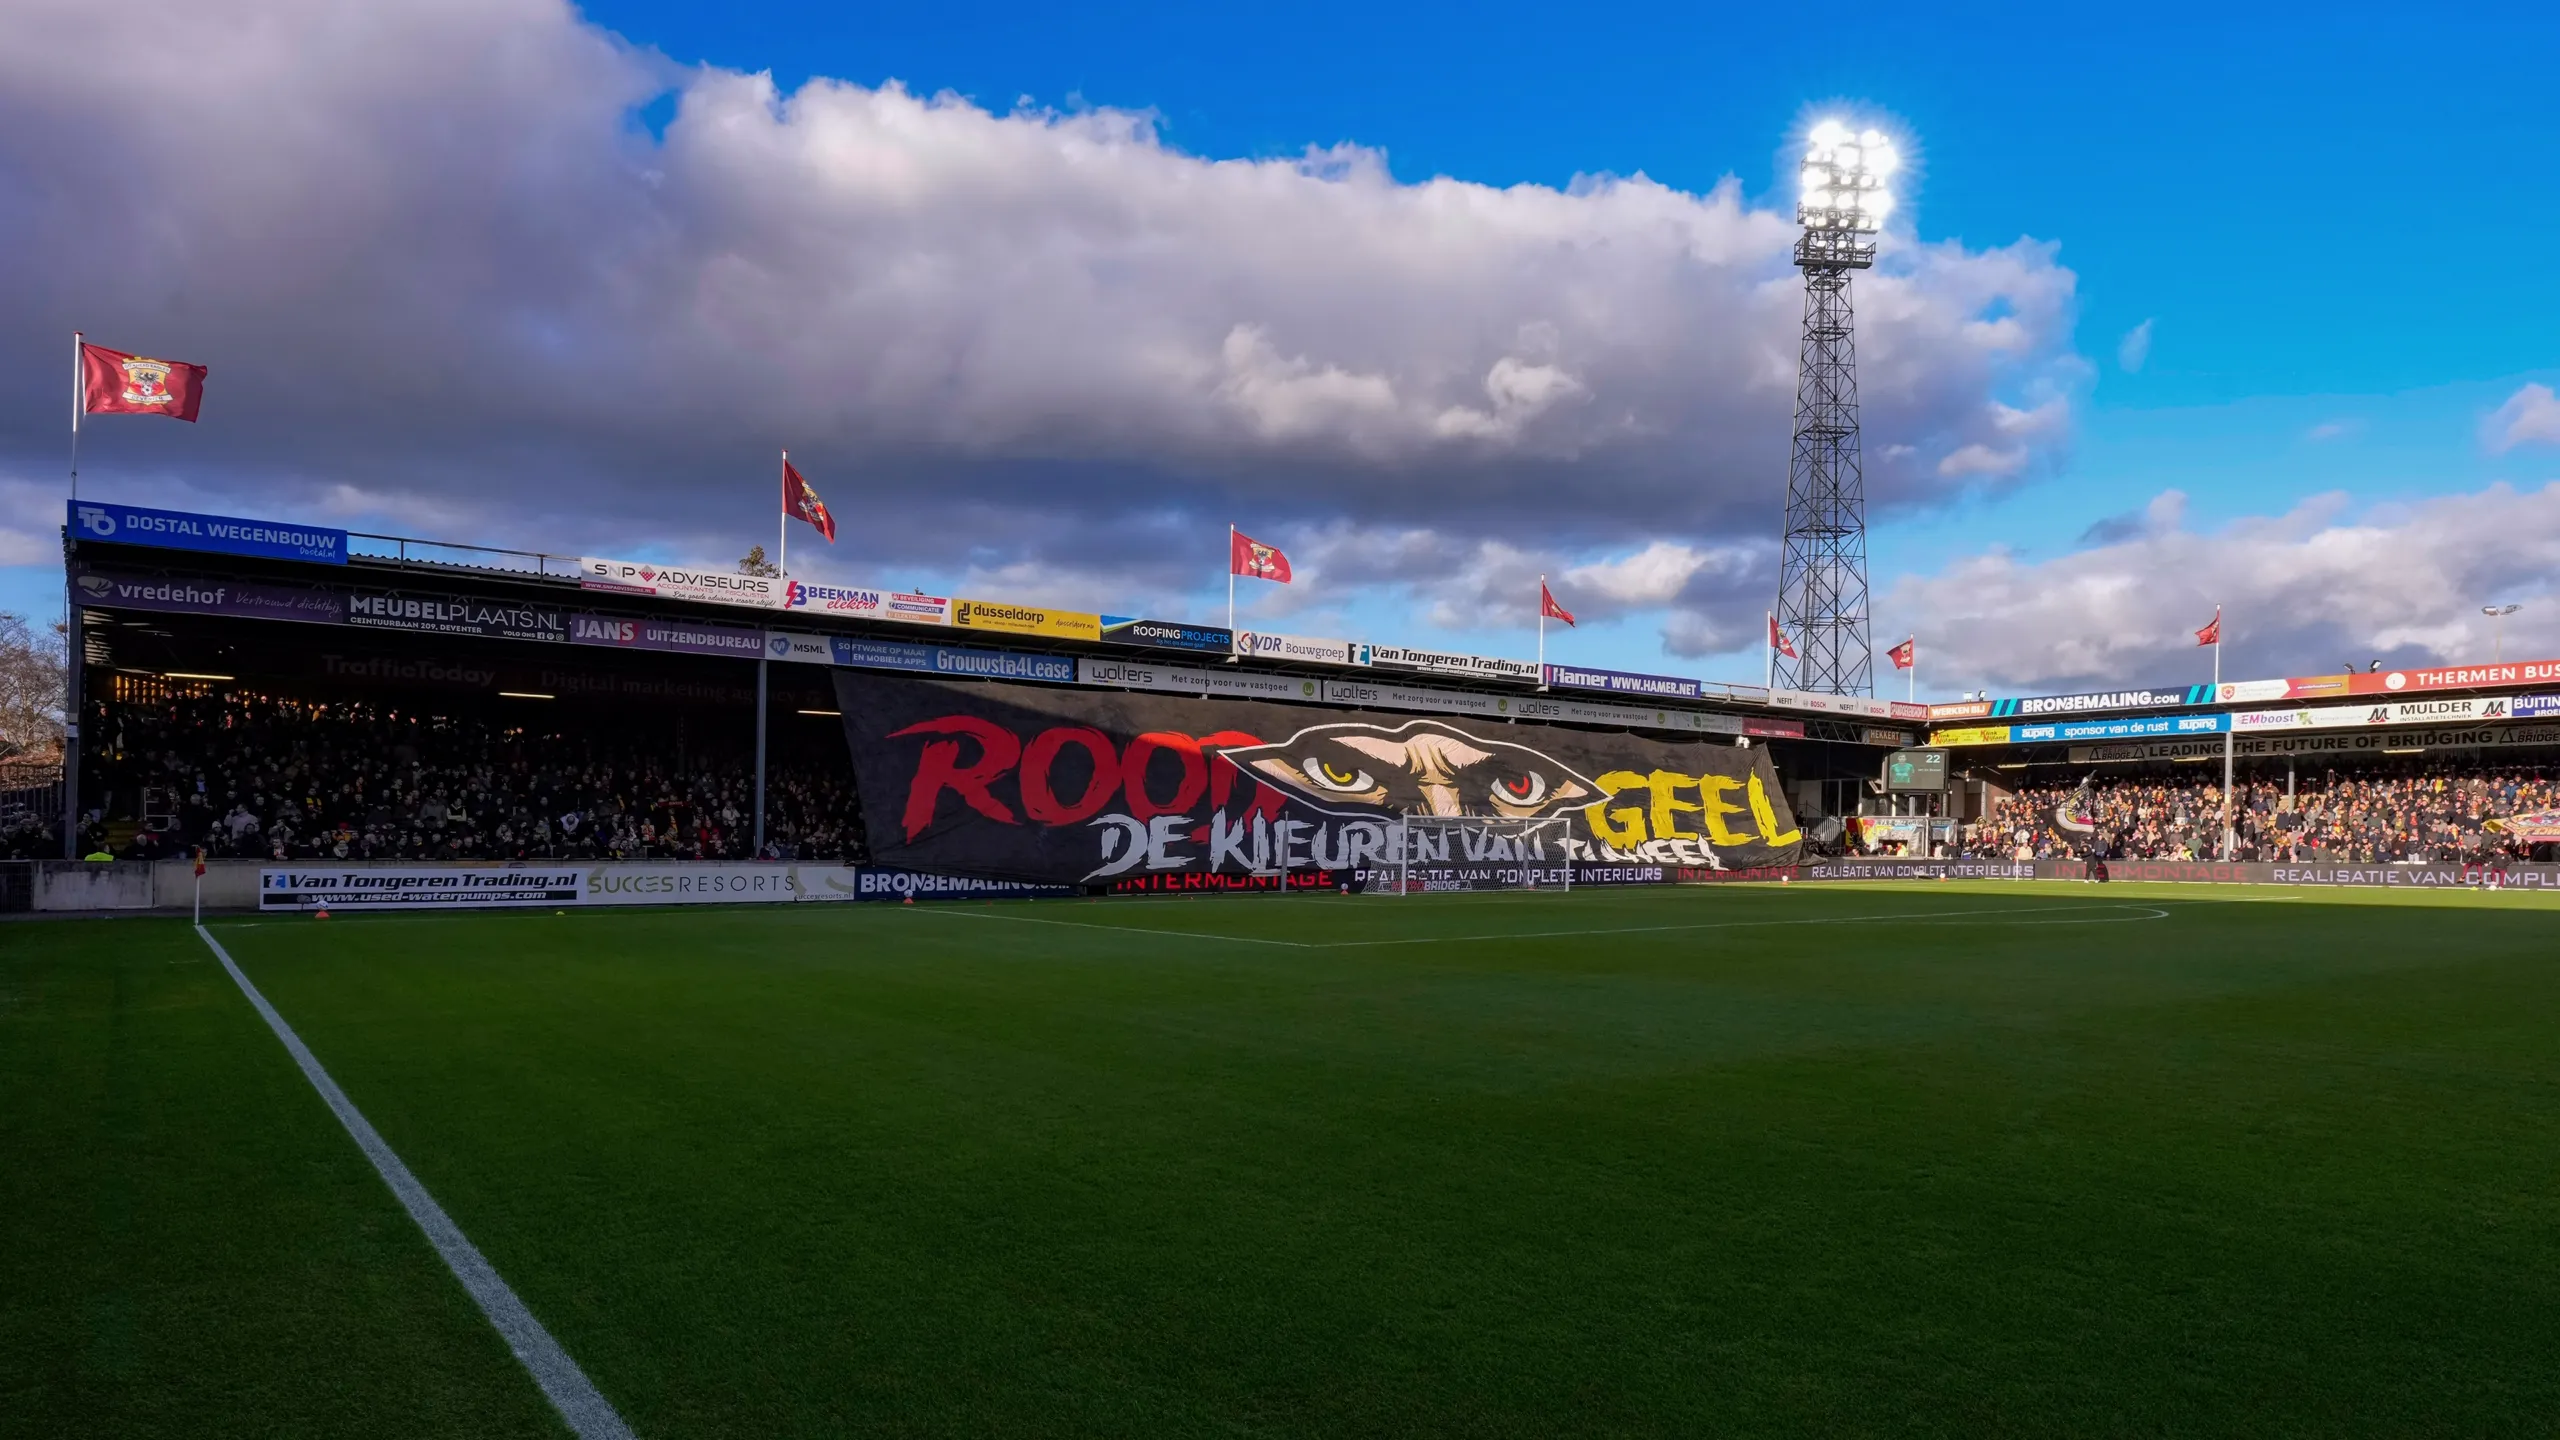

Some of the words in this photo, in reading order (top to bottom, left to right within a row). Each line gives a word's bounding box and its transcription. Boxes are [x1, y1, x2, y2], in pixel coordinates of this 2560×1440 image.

[126, 515, 202, 536] DOSTAL
[208, 523, 336, 549] WEGENBOUW
[594, 564, 636, 577] SNP
[656, 571, 769, 592] ADVISEURS
[118, 583, 225, 605] vredehof
[656, 583, 714, 594] ACCOUNTANTS
[725, 590, 770, 598] FISCALISTEN
[808, 586, 879, 604] BEEKMAN
[236, 592, 295, 608] Vertrouwd
[827, 596, 877, 610] elektro
[900, 595, 934, 604] BEVEILIGING
[350, 596, 564, 631] MEUBELPLAATS.NL
[896, 604, 940, 613] COMMUNICATIE
[974, 604, 1044, 624] dusseldorp
[350, 616, 419, 629] CEINTUURBAAN
[440, 624, 482, 634] DEVENTER
[576, 619, 634, 641] JANS
[646, 628, 761, 650] UITZENDBUREAU
[1133, 625, 1230, 644] ROOFINGPROJECTS
[794, 644, 826, 654] MSML
[838, 642, 888, 655] SOFTWARE
[890, 647, 901, 655] OP
[904, 648, 926, 658] MAAT
[1254, 636, 1282, 652] VDR
[1286, 643, 1344, 661] Bouwgroep
[853, 653, 864, 662] EN
[866, 654, 902, 664] MOBIELE
[904, 658, 927, 666] APPS
[1372, 646, 1399, 660] Van
[1401, 649, 1468, 667] Tongeren
[1471, 656, 1538, 675] Trading.nl
[1092, 666, 1152, 682] wolters
[1553, 668, 1608, 688] Hamer
[1611, 676, 1696, 696] WWW.HAMER.NET
[2417, 667, 2516, 686] THERMEN
[540, 669, 616, 694] Digital
[622, 677, 726, 702] marketing
[1172, 674, 1187, 684] Met
[1190, 677, 1210, 687] zorg
[1212, 678, 1232, 687] voor
[1236, 680, 1247, 688] uw
[1250, 682, 1288, 692] vastgoed
[1332, 686, 1378, 700] wolters
[1392, 692, 1406, 701] Met
[1408, 695, 1424, 704] zorg
[1455, 699, 1486, 708] vastgoed
[1518, 702, 1560, 716] wolters
[1776, 697, 1792, 705] NEFIT
[1810, 700, 1826, 708] BOSCH
[1870, 706, 1884, 714] BOSCH
[2022, 691, 2180, 714] BRONBEMALING.COM
[2400, 702, 2472, 715] MULDER
[1583, 710, 1597, 718] zorg
[1622, 713, 1648, 722] vastgoed
[1932, 706, 1970, 717] WERKEN
[1971, 706, 1985, 714] BIJ
[2240, 714, 2294, 724] EMboost
[2400, 714, 2472, 722] INSTALLATIETECHNIEK
[2064, 726, 2106, 738] sponsor
[2108, 724, 2128, 734] van
[2130, 722, 2144, 733] de
[2146, 722, 2168, 732] rust
[2178, 718, 2216, 731] auping
[1870, 730, 1900, 740] HEKKERT
[2022, 728, 2055, 738] auping
[2518, 734, 2559, 742] BRIDGE
[2150, 743, 2224, 756] LEADING
[2232, 742, 2266, 754] THE
[2272, 738, 2348, 752] FUTURE
[2356, 736, 2380, 748] OF
[2388, 731, 2493, 747] BRIDGING
[1926, 754, 1941, 764] 22
[2102, 752, 2130, 760] BRIDGE
[1584, 766, 1801, 847] GEEL
[1080, 813, 1196, 882] DE
[1210, 806, 1451, 875] KLEUREN
[1460, 823, 1545, 861] VAN
[1581, 868, 1662, 882] INTERIEURS
[1812, 866, 1871, 878] REALISATIE
[1874, 865, 1894, 877] VAN
[1897, 864, 1946, 876] COMPLETE
[1948, 864, 2035, 876] INTERIEURS
[2055, 864, 2247, 881] INTERMONTAGE
[2273, 869, 2400, 884] REALISATIE
[2408, 872, 2455, 884] VAN
[290, 874, 338, 888] Van
[342, 874, 460, 890] Tongeren
[462, 873, 578, 888] Trading.nl
[311, 890, 546, 903] www.used-waterpumps.com
